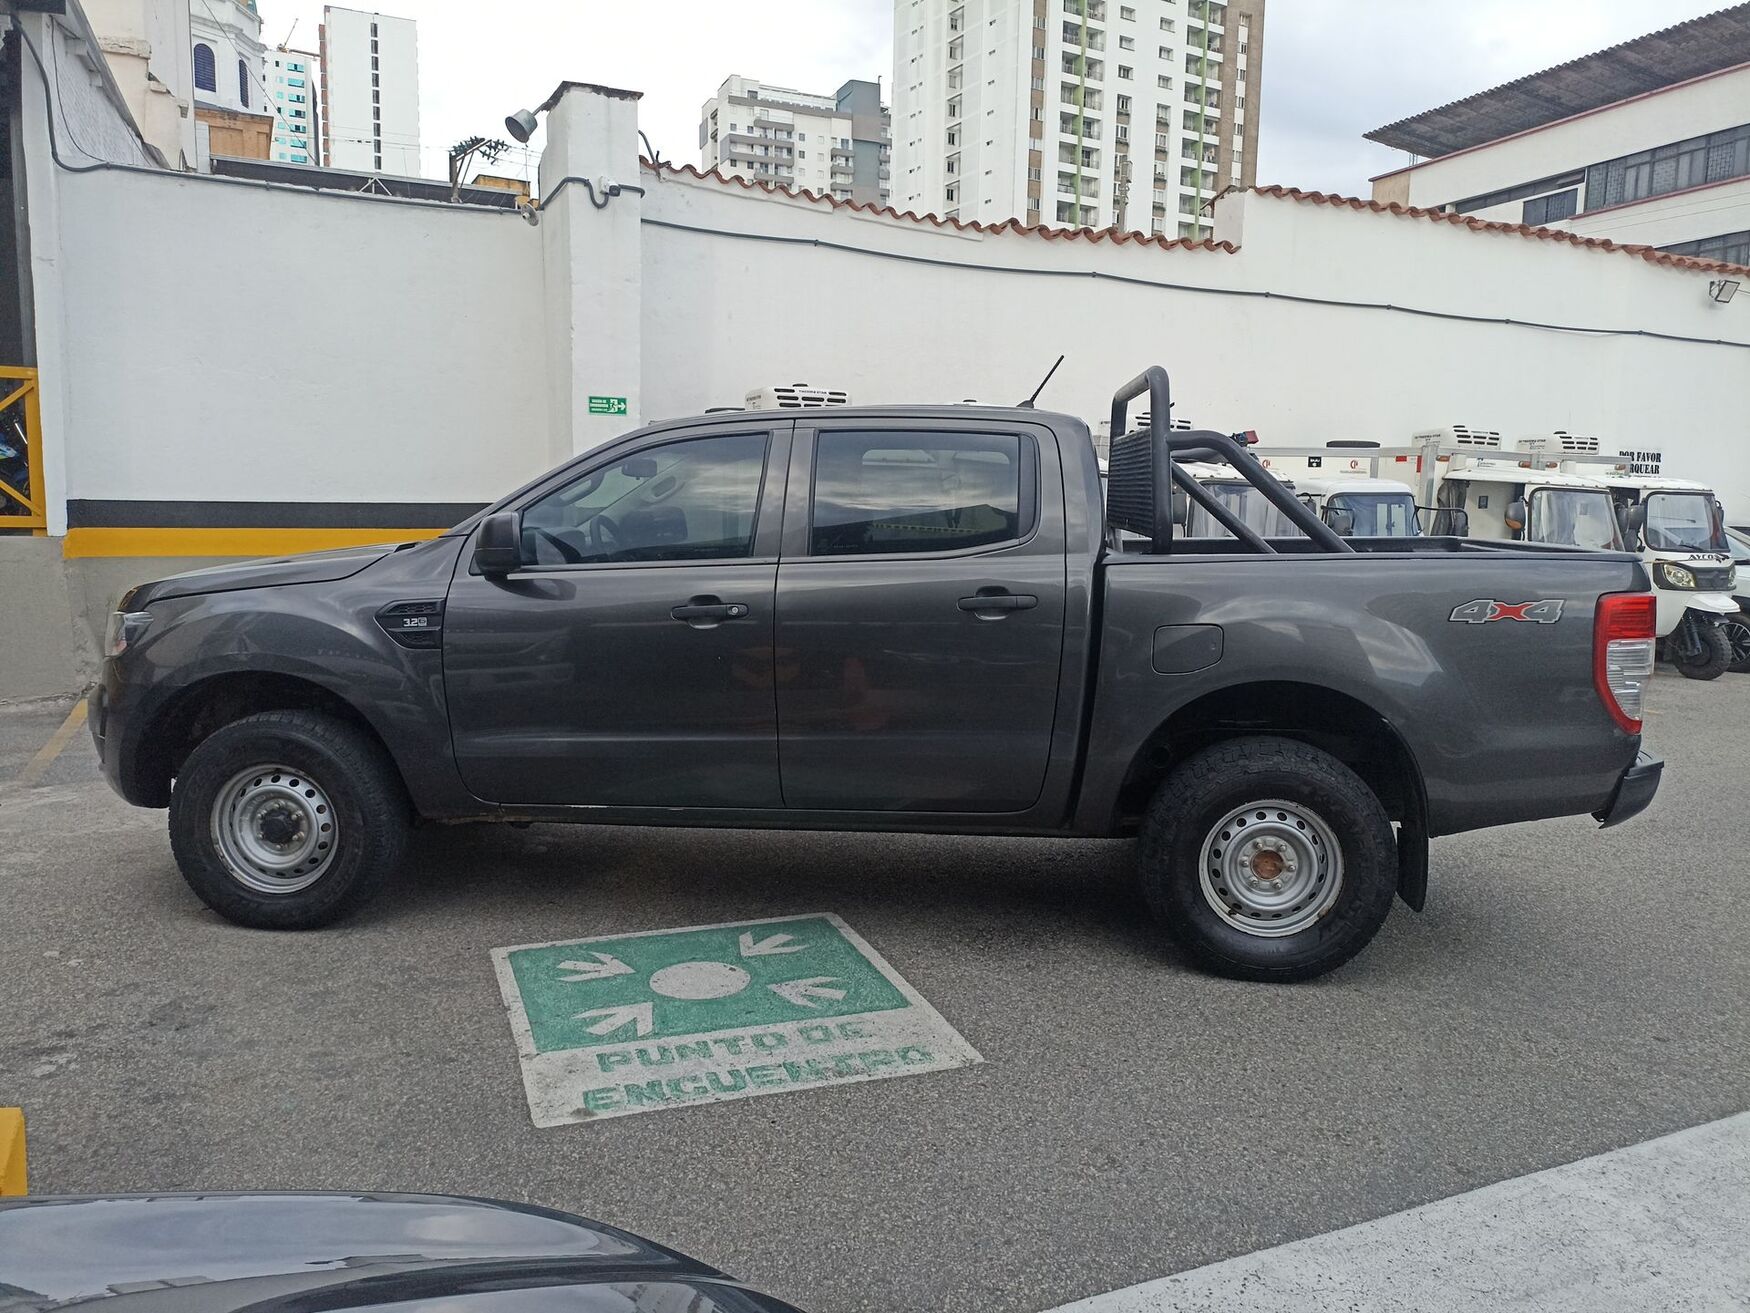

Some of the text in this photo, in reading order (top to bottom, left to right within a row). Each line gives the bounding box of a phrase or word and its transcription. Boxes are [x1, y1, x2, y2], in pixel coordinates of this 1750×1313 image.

[1629, 464, 1660, 474] RQUEAR
[1636, 452, 1661, 462] FAVOR
[596, 1021, 873, 1072] PUNTO DE
[583, 1045, 936, 1111] ENCUENTRO
